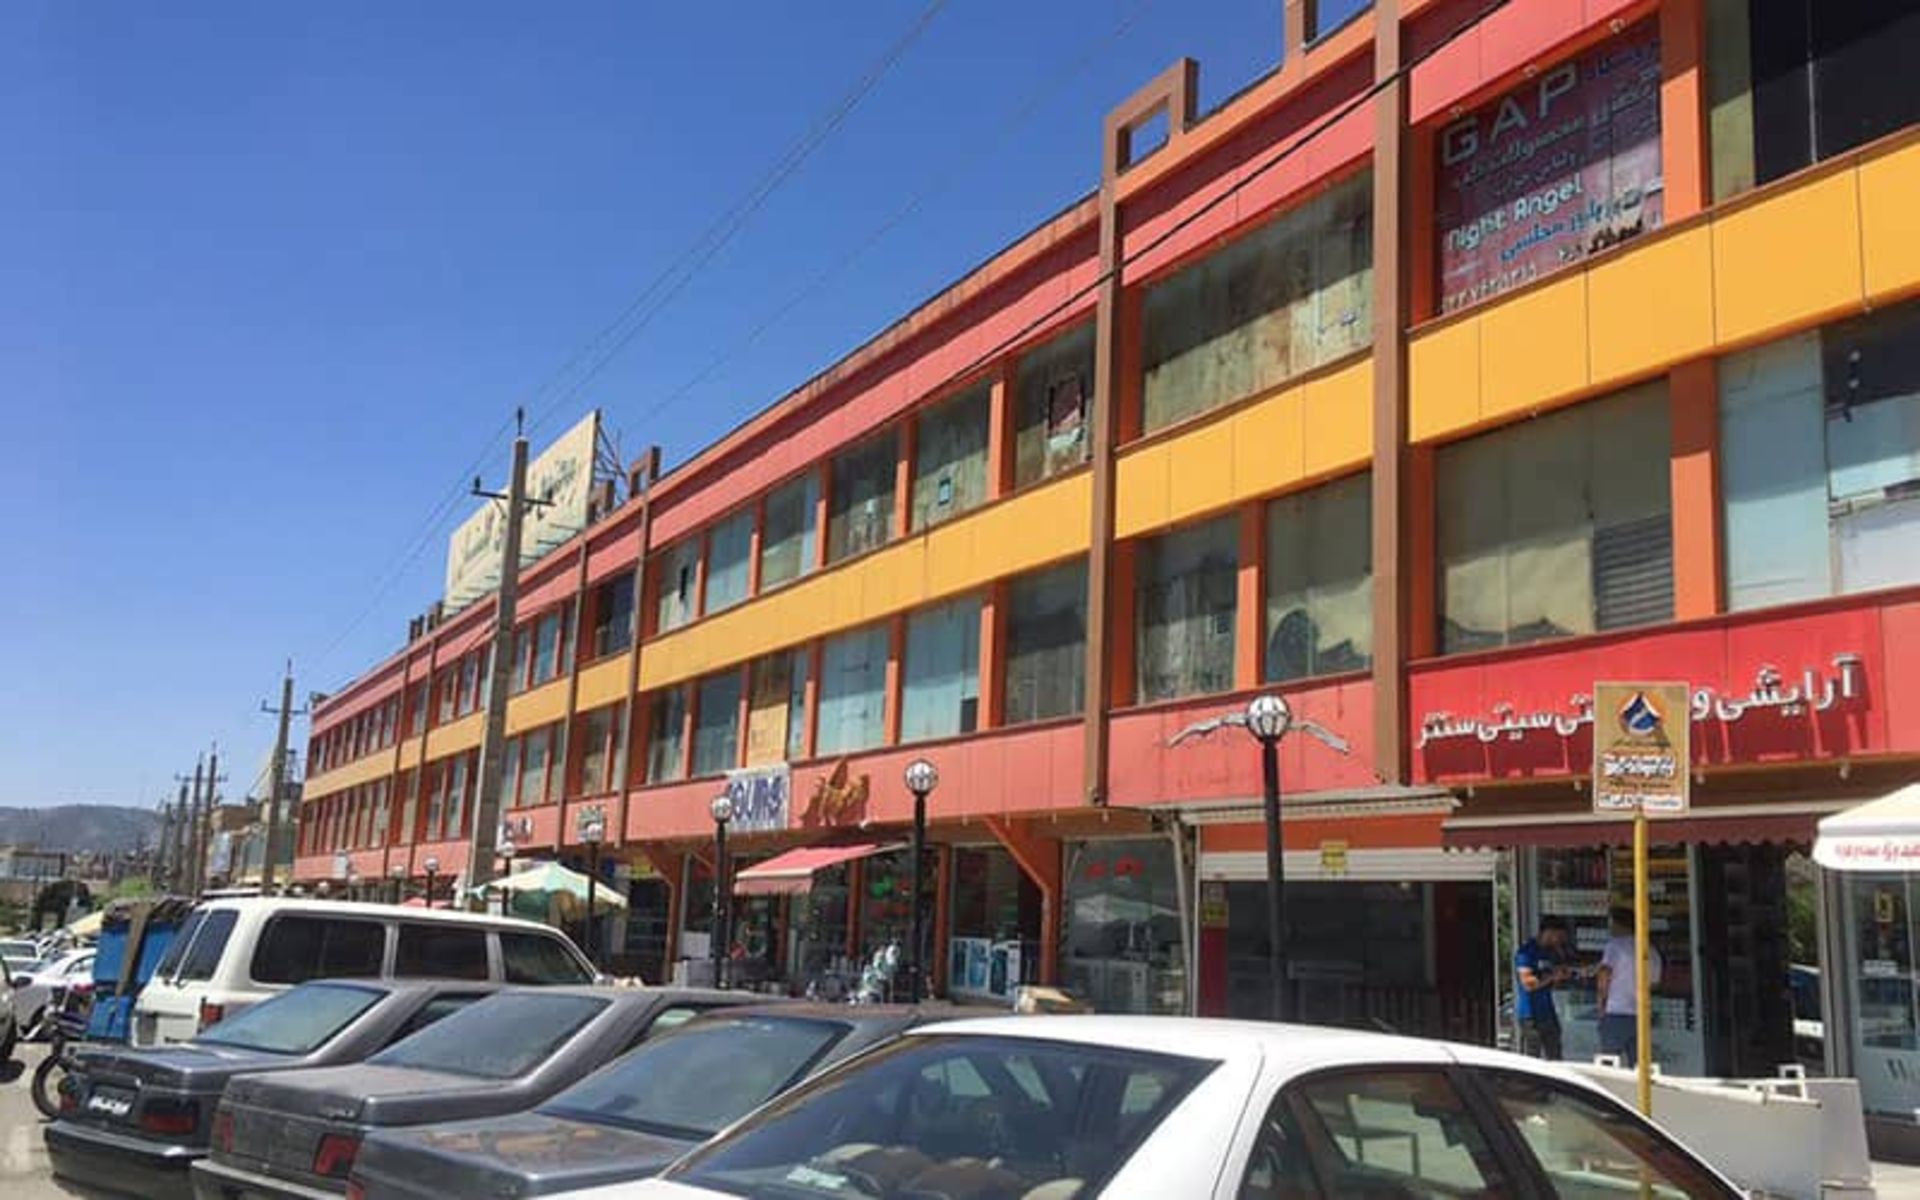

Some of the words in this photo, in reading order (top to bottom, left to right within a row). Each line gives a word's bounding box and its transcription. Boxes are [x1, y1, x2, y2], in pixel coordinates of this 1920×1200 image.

[1443, 61, 1577, 166] GAP
[1514, 172, 1582, 222] Angel
[1692, 688, 1712, 721] و
[1716, 653, 1861, 721] آرایشی
[1417, 710, 1477, 749] سنتر
[1476, 702, 1553, 743] سیتی
